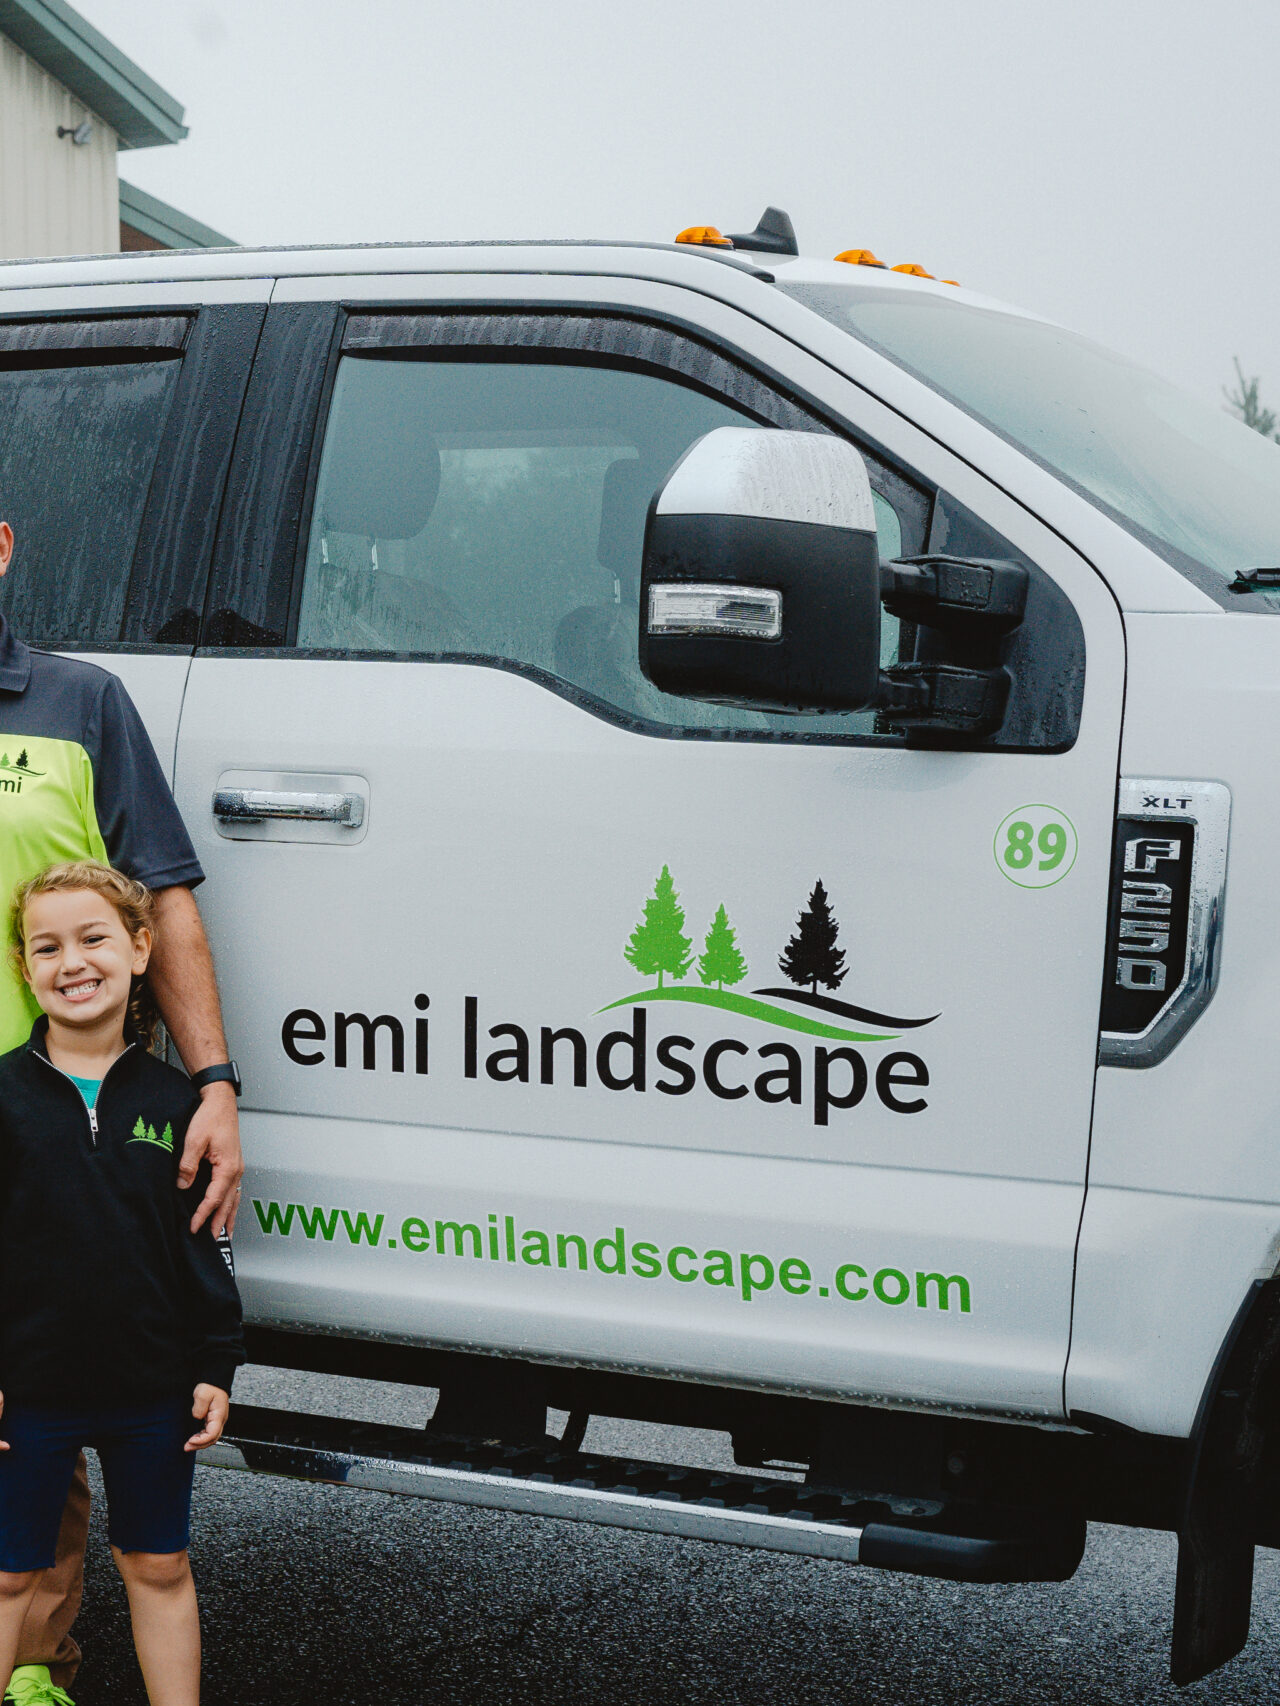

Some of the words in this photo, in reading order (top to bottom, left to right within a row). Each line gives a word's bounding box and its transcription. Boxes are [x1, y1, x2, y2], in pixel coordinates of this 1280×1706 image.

[1004, 821, 1067, 871] 89
[1142, 797, 1193, 809] XLT
[1116, 838, 1181, 992] F250
[281, 993, 430, 1075] emi
[464, 995, 930, 1127] landscape
[252, 1199, 972, 1313] www.emilandscape.com
